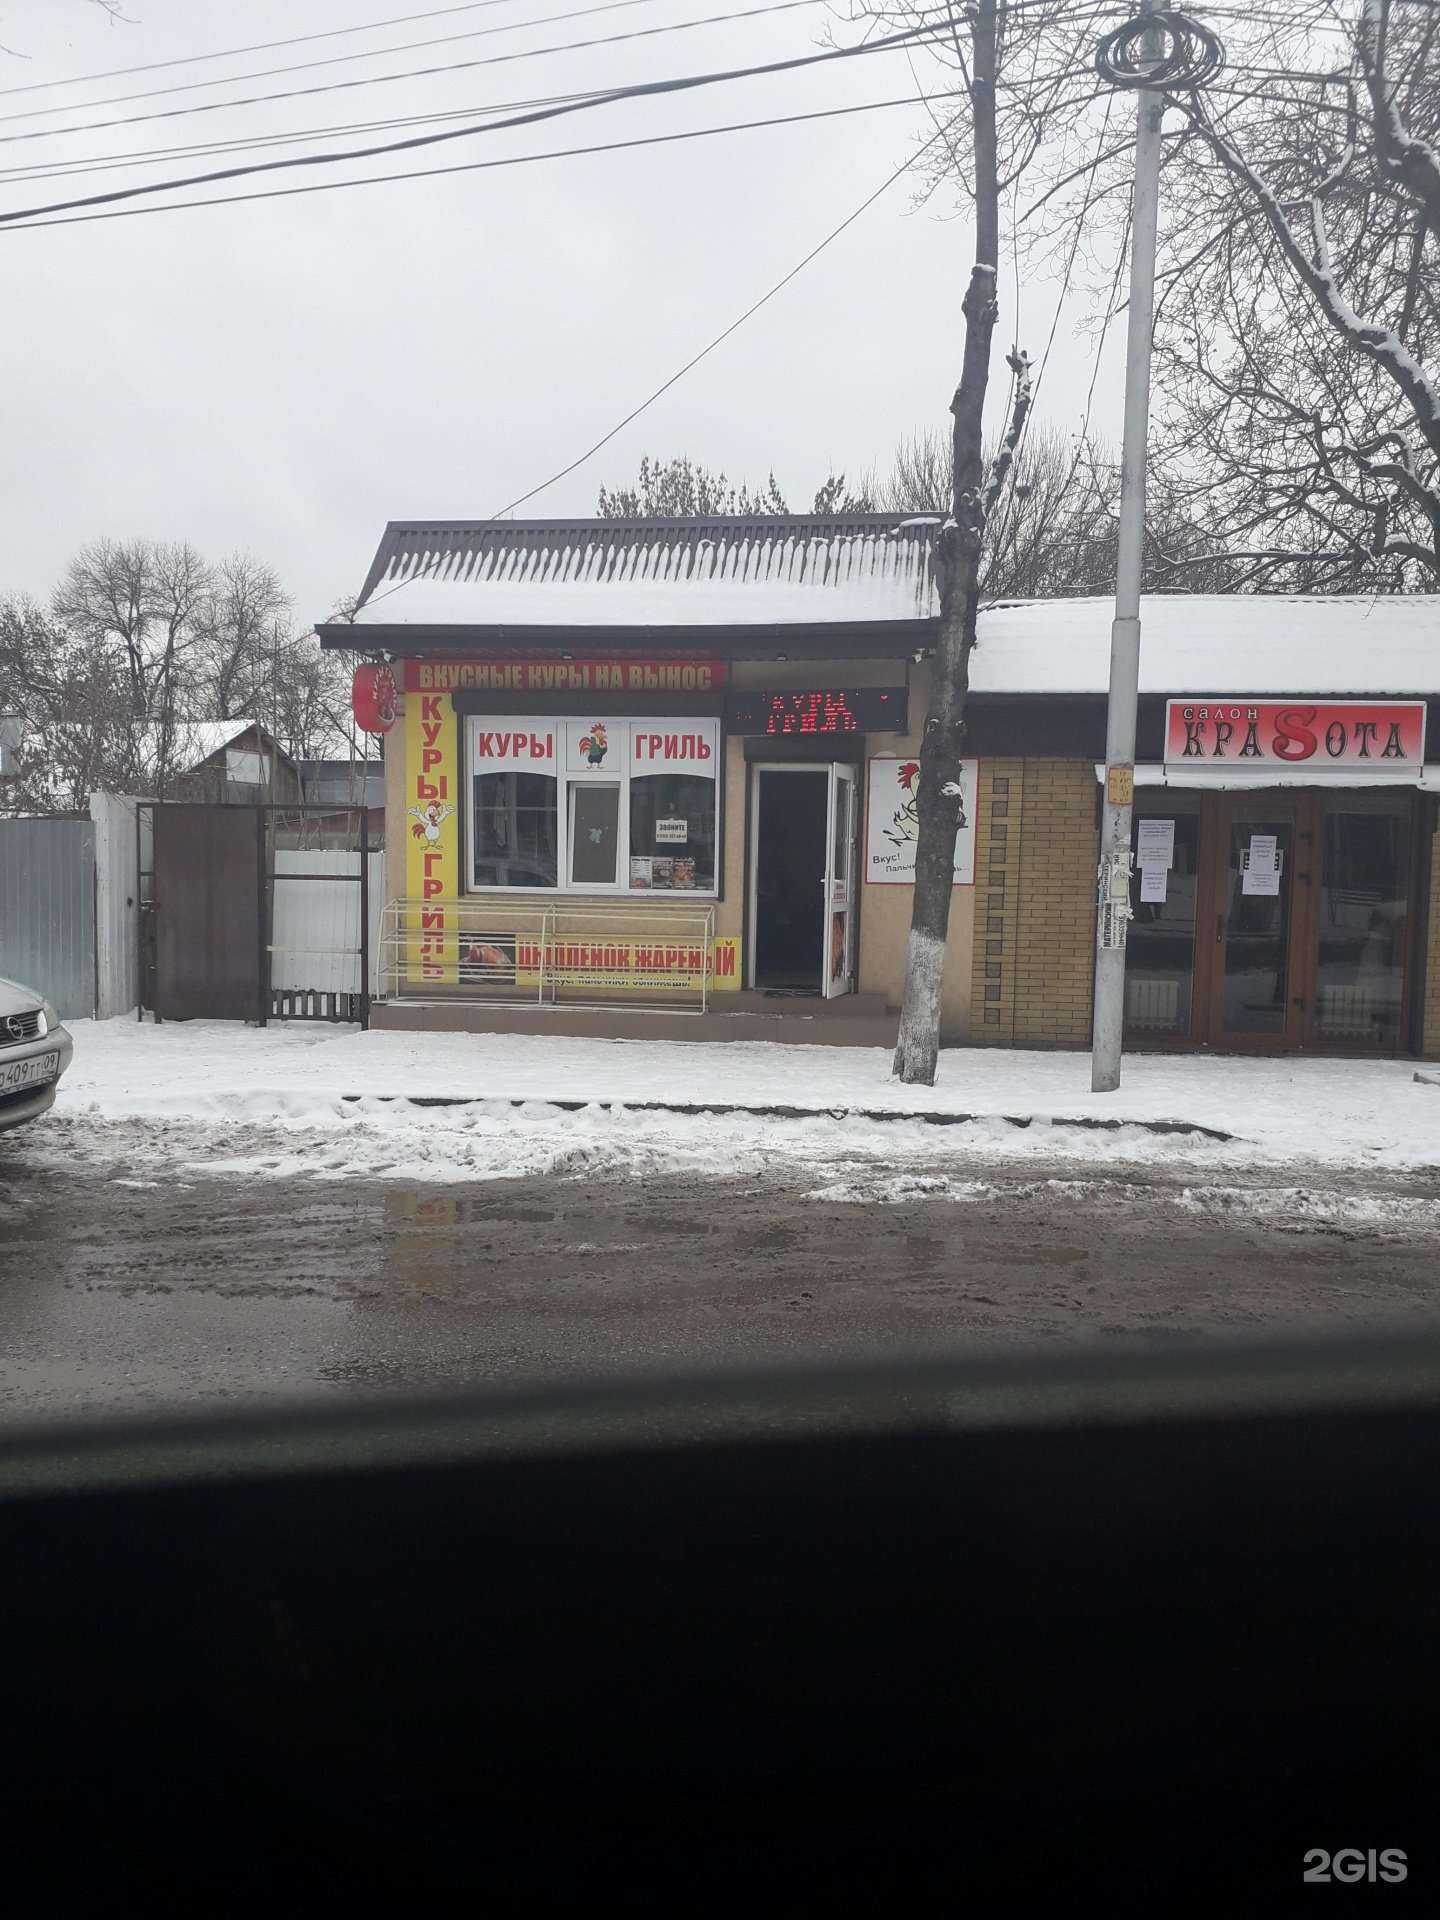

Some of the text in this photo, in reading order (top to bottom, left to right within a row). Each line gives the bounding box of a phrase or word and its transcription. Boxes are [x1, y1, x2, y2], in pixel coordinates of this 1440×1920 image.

[419, 665, 522, 689] ВКУСНЫЕ
[528, 665, 590, 689] КУРЫ
[596, 665, 623, 689] НА
[629, 665, 712, 690] ВЫНОС
[1183, 706, 1258, 720] салон
[417, 695, 448, 800] КУРЫ
[479, 732, 553, 758] КУРЫ
[635, 734, 711, 760] ГРИЛЬ
[872, 853, 900, 864] Вкус!
[420, 853, 444, 979] ГРИЛЬ
